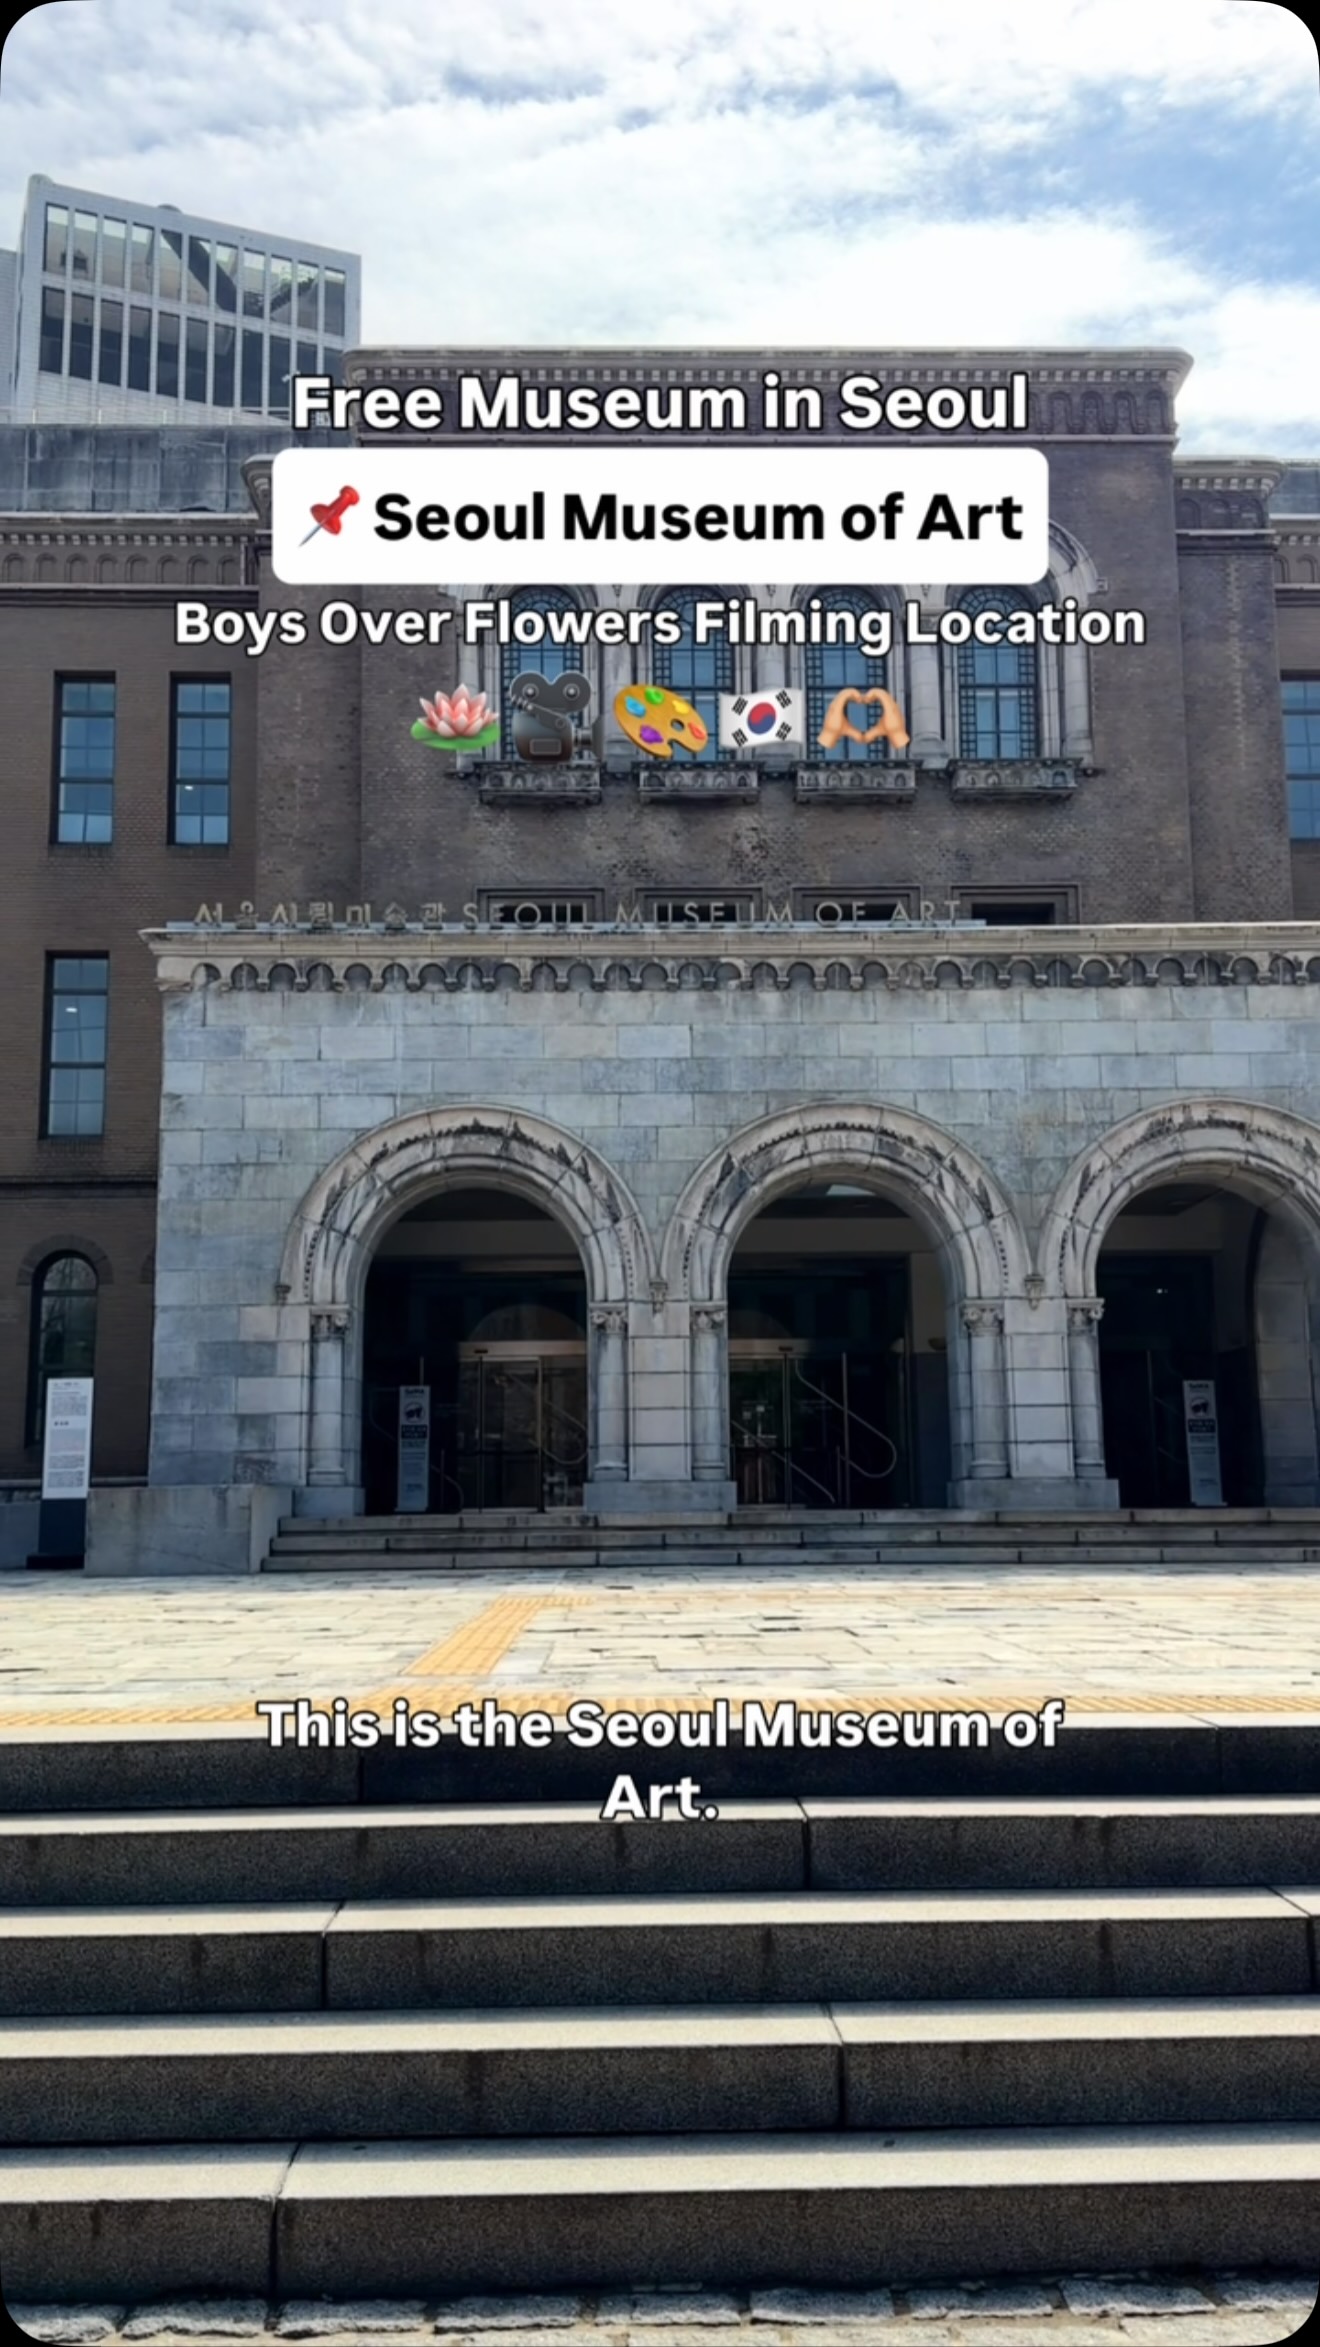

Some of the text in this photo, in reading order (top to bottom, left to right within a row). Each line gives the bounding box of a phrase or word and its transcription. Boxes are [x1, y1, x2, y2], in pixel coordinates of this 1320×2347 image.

[462, 900, 962, 929] SEOUL MUSEUM OF ART
